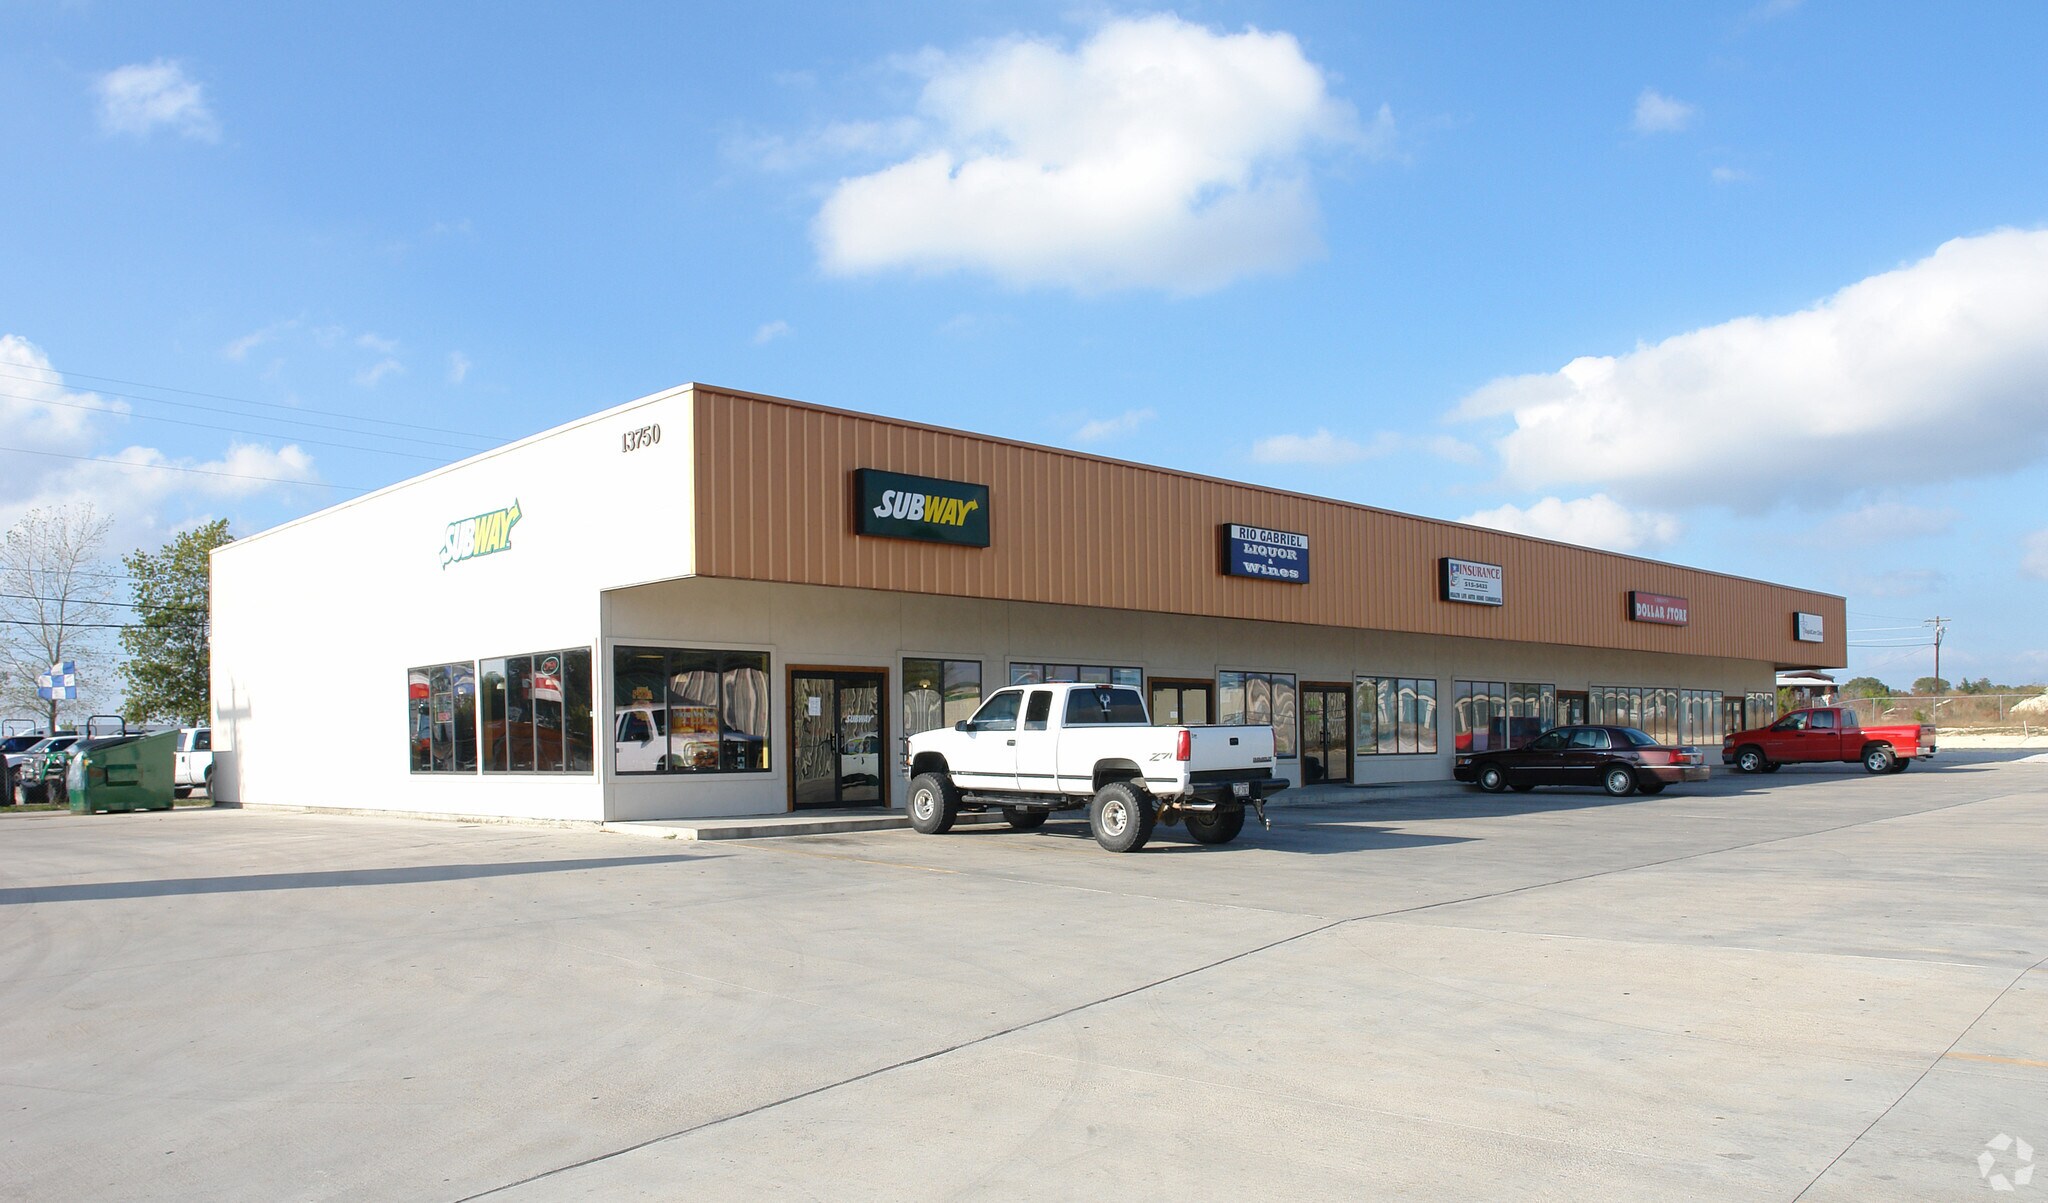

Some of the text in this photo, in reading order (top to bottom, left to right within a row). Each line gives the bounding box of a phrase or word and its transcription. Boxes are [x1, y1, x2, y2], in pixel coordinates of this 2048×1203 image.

[622, 423, 661, 453] 13750
[873, 489, 979, 527] SUBWAY
[439, 498, 522, 571] SUBWAY
[1239, 527, 1302, 547] RIO GABRIEL
[1243, 543, 1298, 560] LIQUOR
[1243, 562, 1299, 578] Wines
[1459, 564, 1501, 580] INSURANCE
[1636, 602, 1687, 622] DOLLAR STORE
[1149, 752, 1173, 762] Z71
